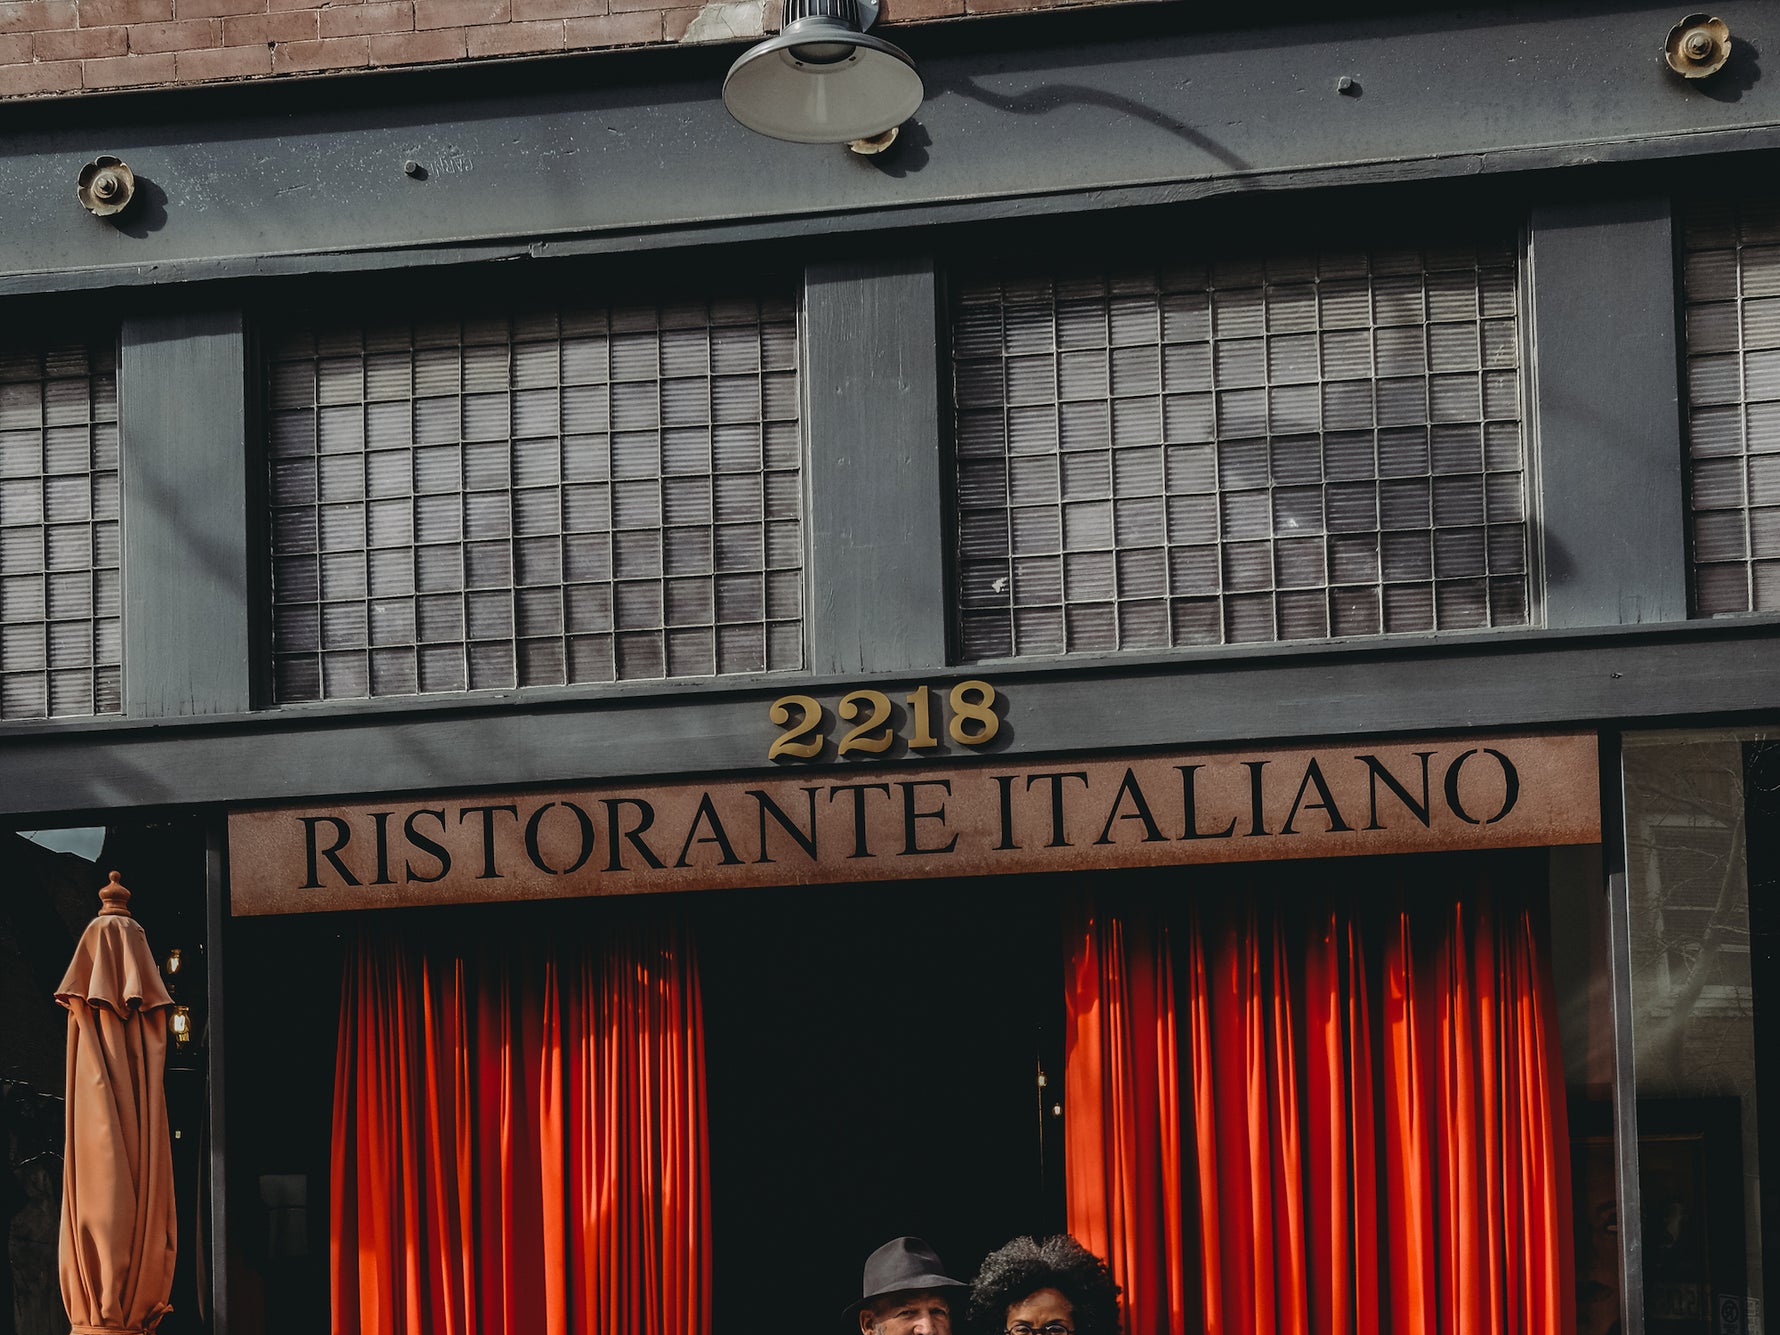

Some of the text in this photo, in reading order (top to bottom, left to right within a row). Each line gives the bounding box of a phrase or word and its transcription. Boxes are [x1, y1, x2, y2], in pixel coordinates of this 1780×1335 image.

[768, 680, 1000, 759] 2218
[296, 747, 1520, 891] RISTORANTE ITALIANO
